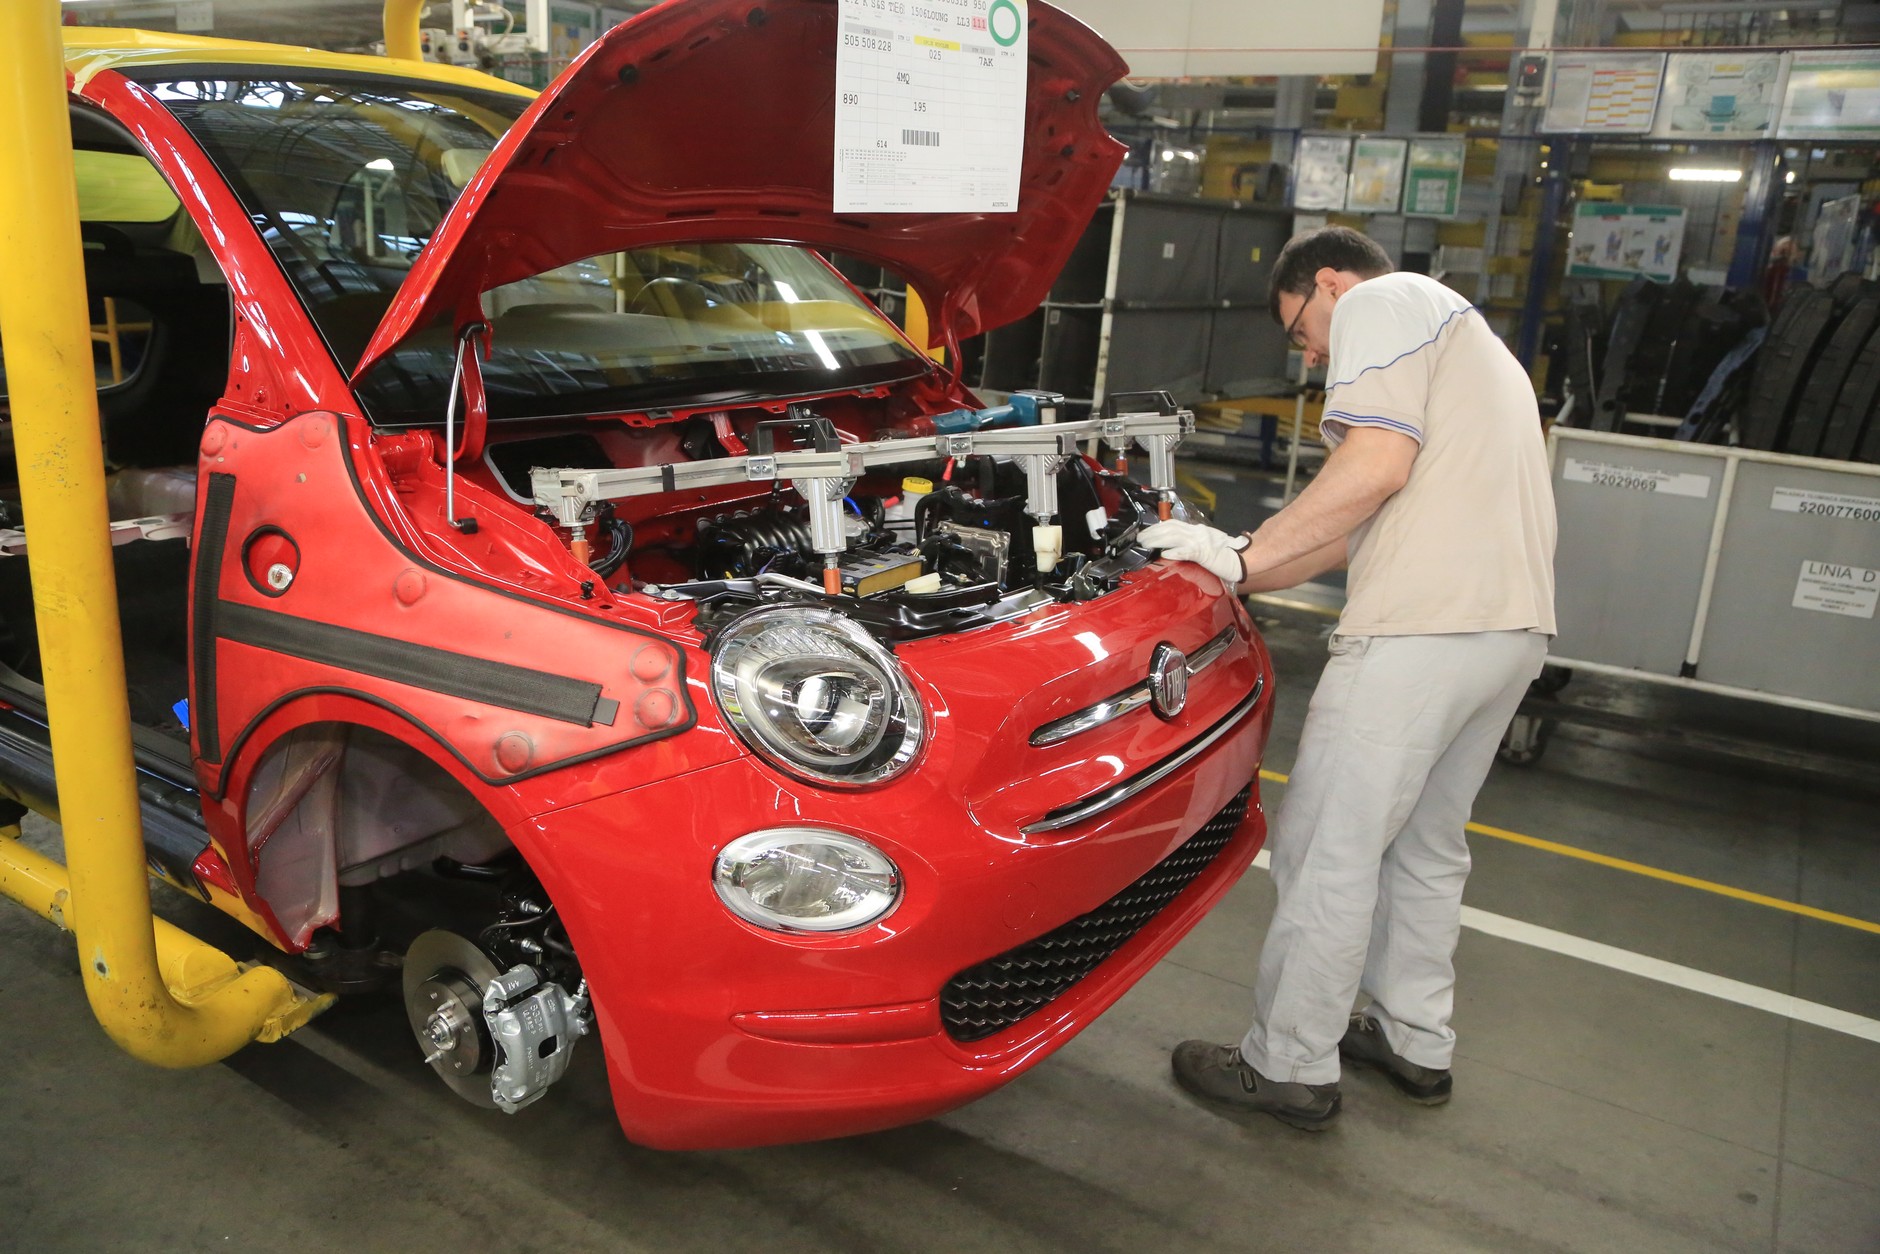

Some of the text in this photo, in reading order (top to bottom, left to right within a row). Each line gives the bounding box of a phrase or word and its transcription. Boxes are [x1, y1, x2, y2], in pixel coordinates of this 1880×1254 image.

[844, 34, 892, 52] 505 508 228
[929, 49, 942, 61] 025
[978, 56, 994, 67] 7AK
[896, 72, 910, 85] 4MQ
[843, 93, 859, 105] 890
[913, 101, 927, 113] 195
[876, 139, 888, 149] 614
[1592, 473, 1657, 491] 52029069
[1799, 502, 1880, 521] 520077600
[1808, 562, 1877, 583] LINIA D
